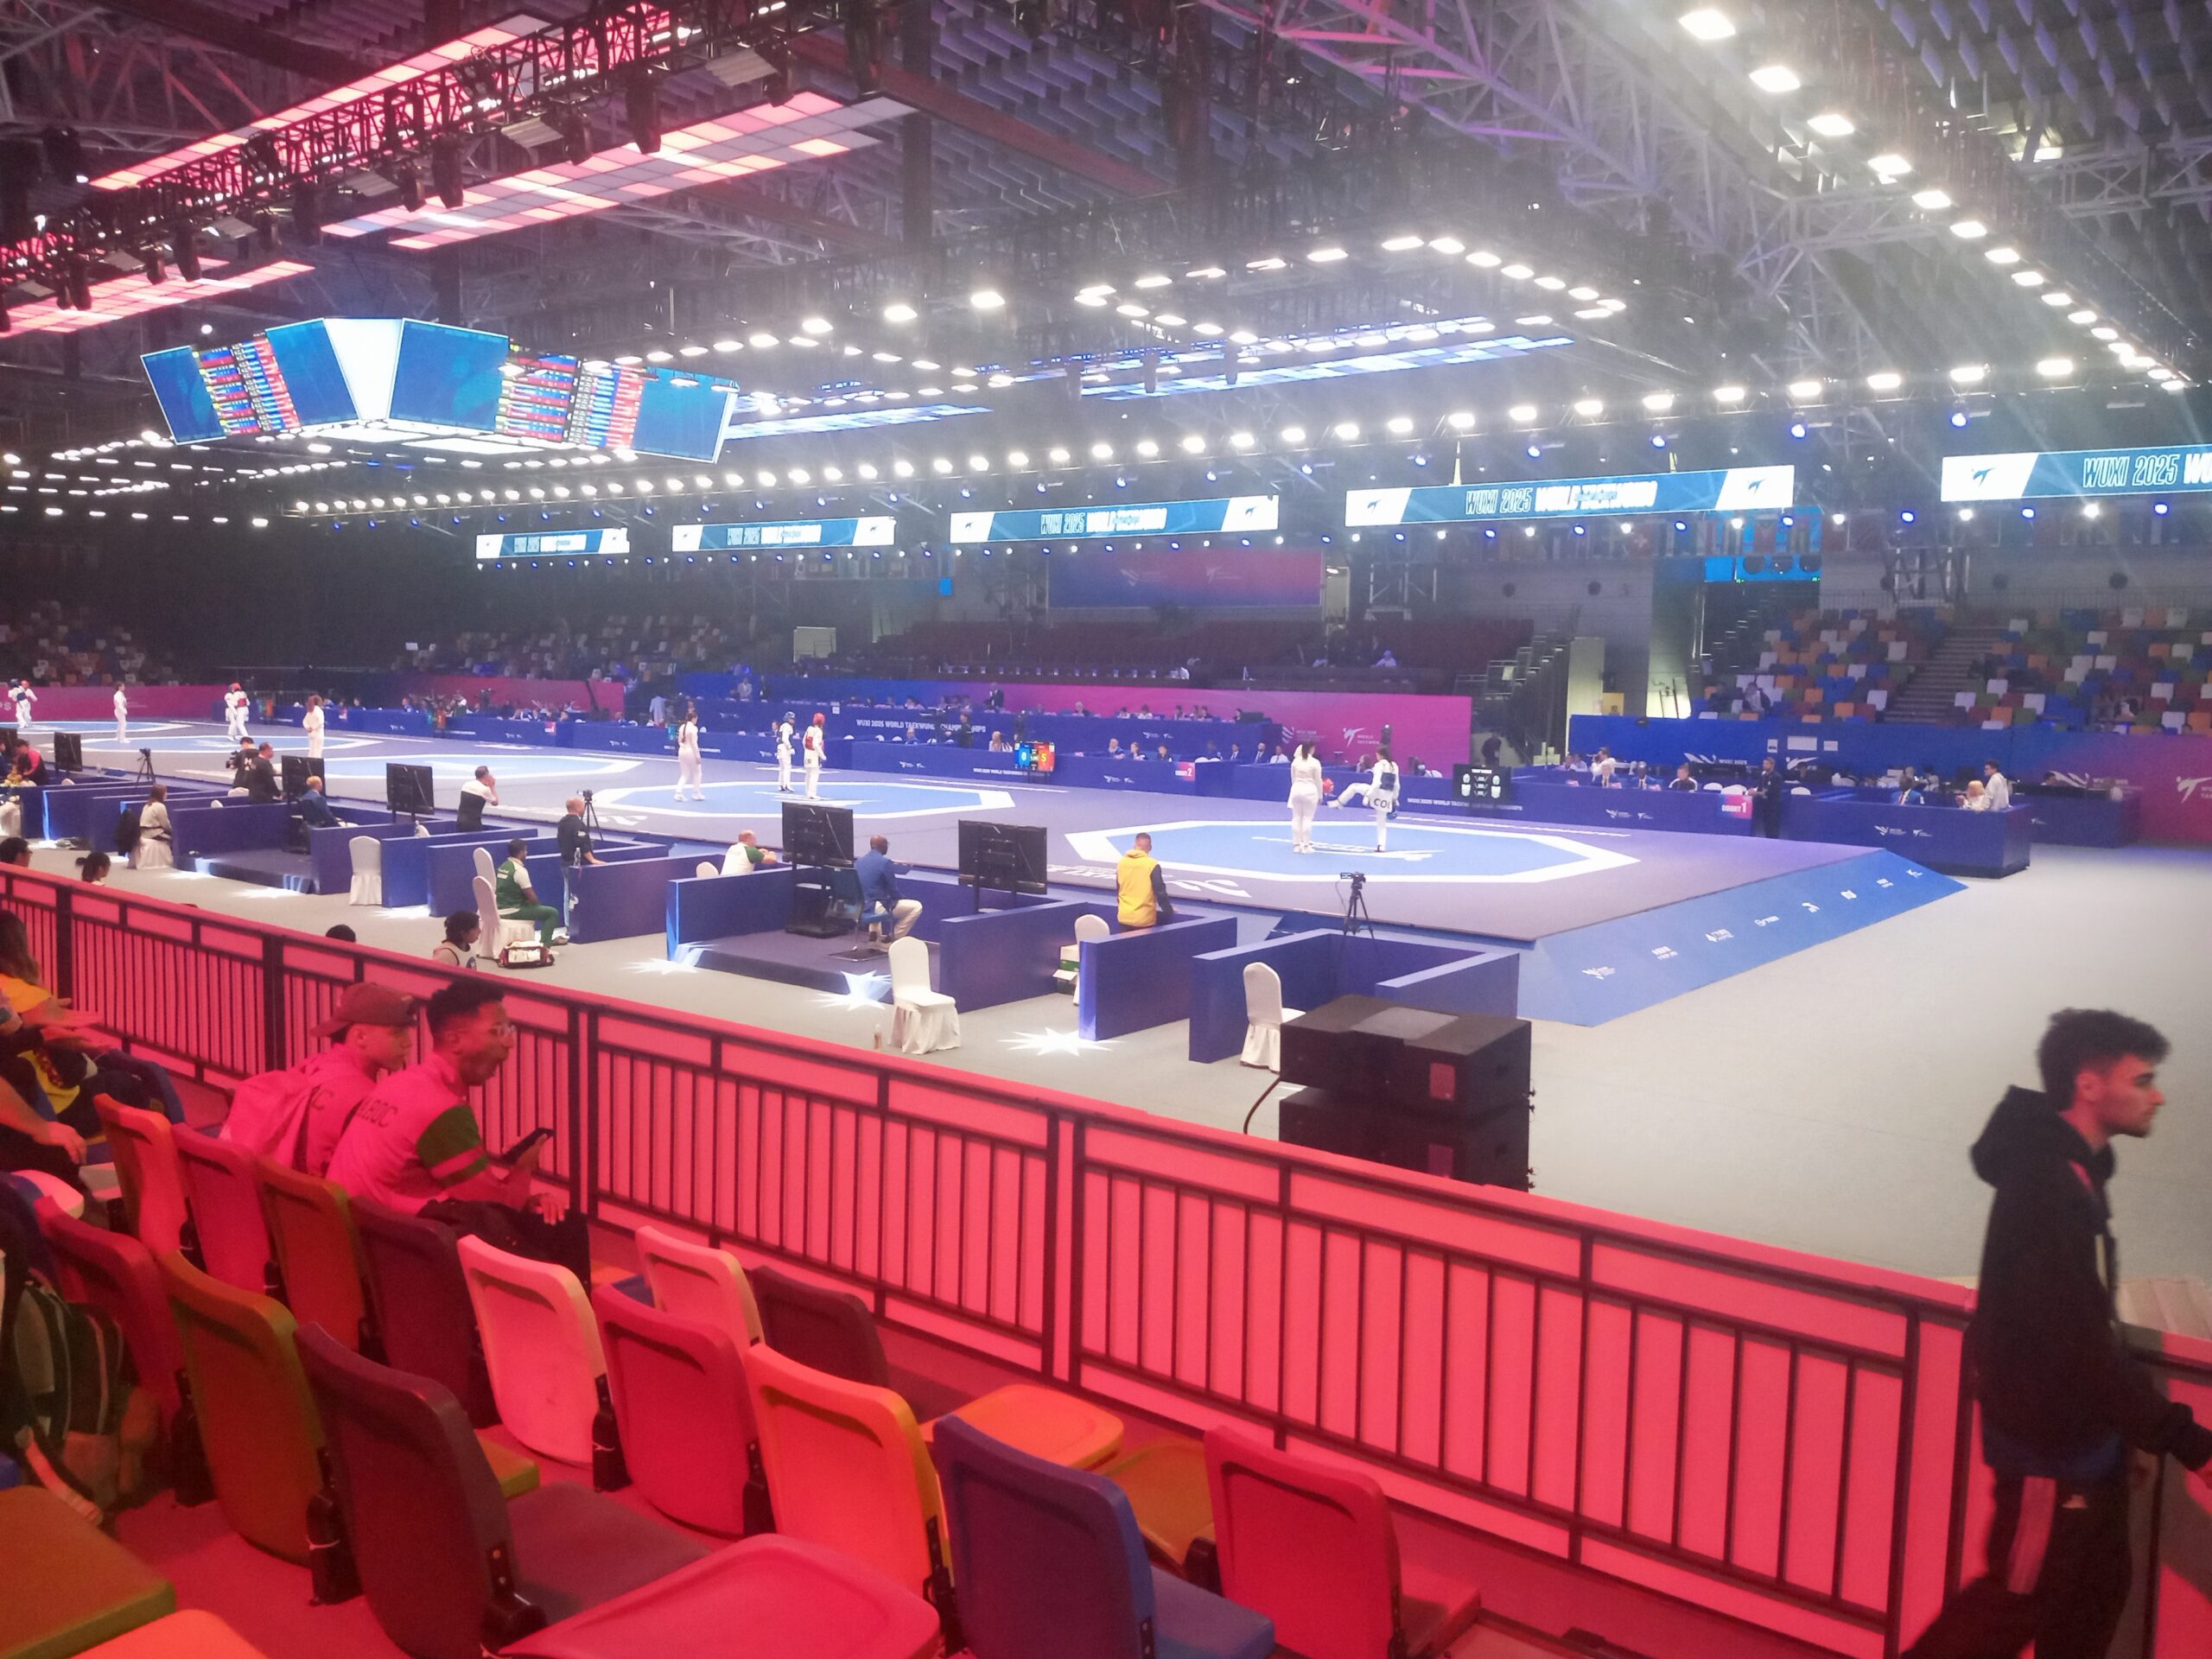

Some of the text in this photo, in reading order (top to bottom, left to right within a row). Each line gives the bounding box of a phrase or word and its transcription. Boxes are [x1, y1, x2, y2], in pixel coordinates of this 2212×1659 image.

[2083, 456, 2130, 488] WUXI
[2132, 454, 2180, 486] 2025
[1465, 491, 1498, 515] WUXI
[1499, 487, 1534, 514] 2025
[1040, 753, 1047, 762] 5
[1741, 801, 1746, 813] 1
